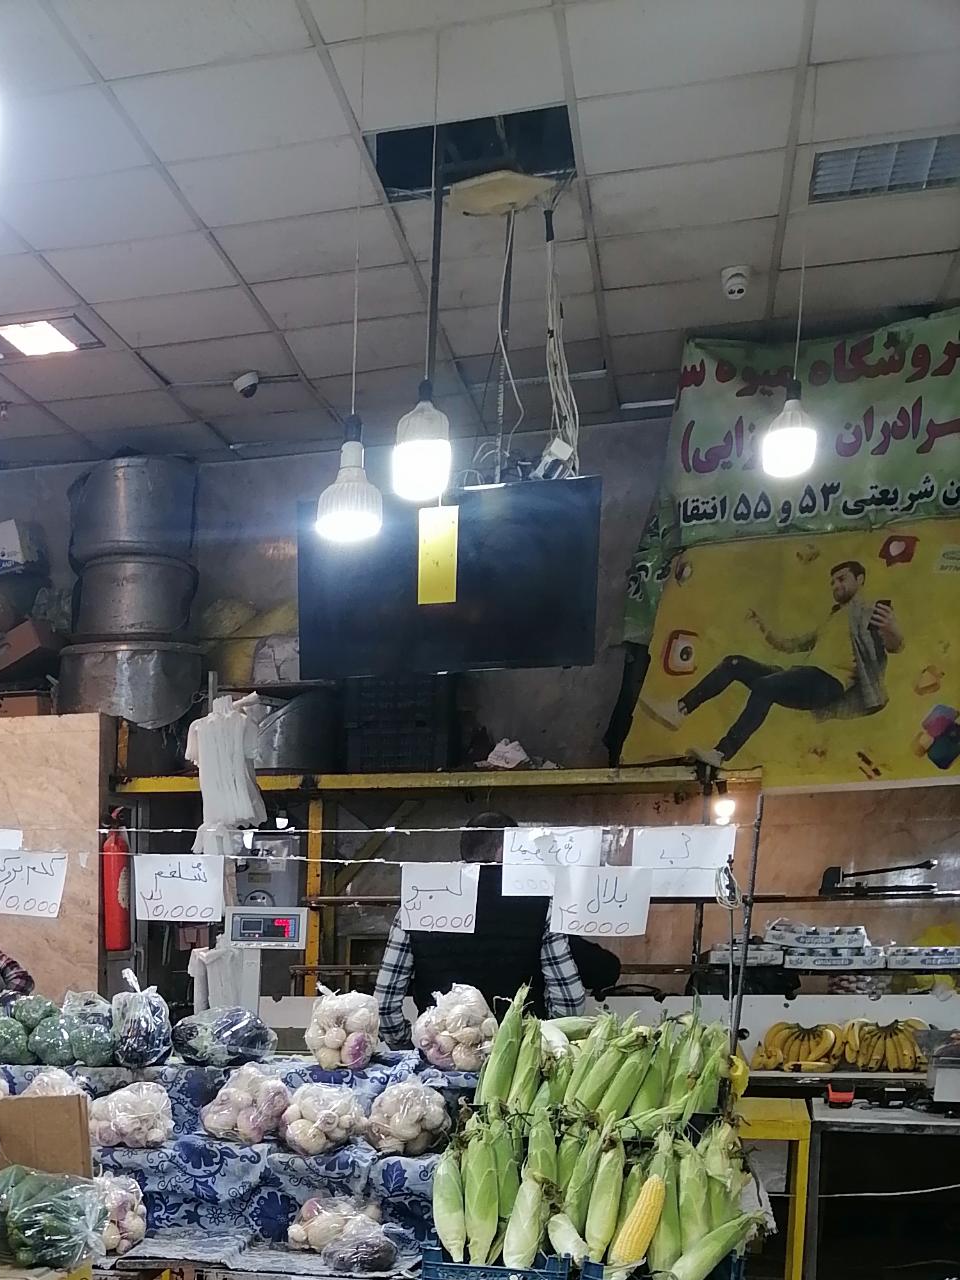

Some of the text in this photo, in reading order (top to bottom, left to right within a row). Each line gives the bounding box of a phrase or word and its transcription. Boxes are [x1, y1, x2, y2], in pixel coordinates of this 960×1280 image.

[808, 332, 960, 387] روشگاه
[835, 395, 960, 457] رادران
[681, 495, 727, 524] انتقا
[733, 491, 772, 521] ۵۵
[777, 500, 791, 524] و
[798, 481, 840, 515] ۵۳
[842, 475, 934, 517] شریعتی
[26, 856, 67, 886] کلم
[154, 861, 208, 892] شلغم
[406, 867, 463, 903] لبو
[587, 873, 628, 914] بلال
